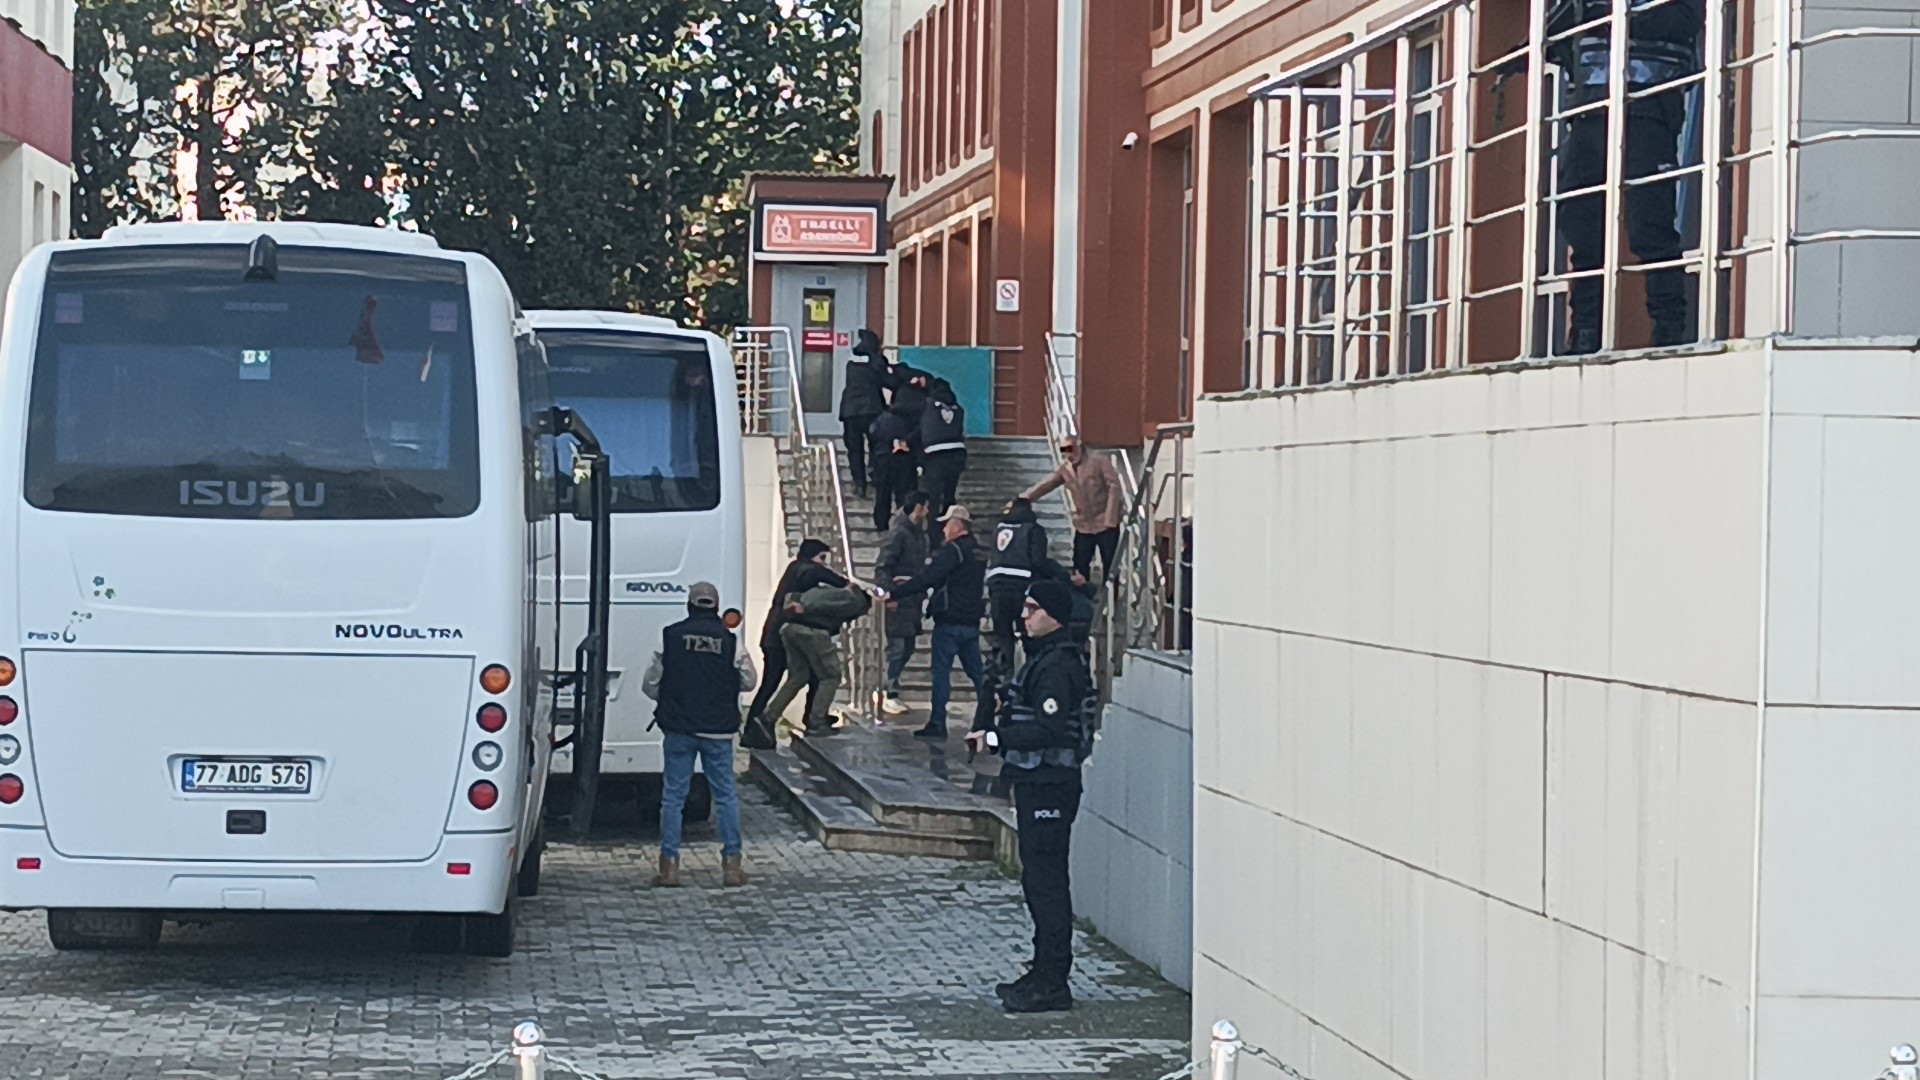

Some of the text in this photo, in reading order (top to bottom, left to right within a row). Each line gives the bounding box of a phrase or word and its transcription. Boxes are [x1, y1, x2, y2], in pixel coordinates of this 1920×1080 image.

[179, 480, 325, 507] ISUZU
[196, 764, 306, 785] 77 ADG 576
